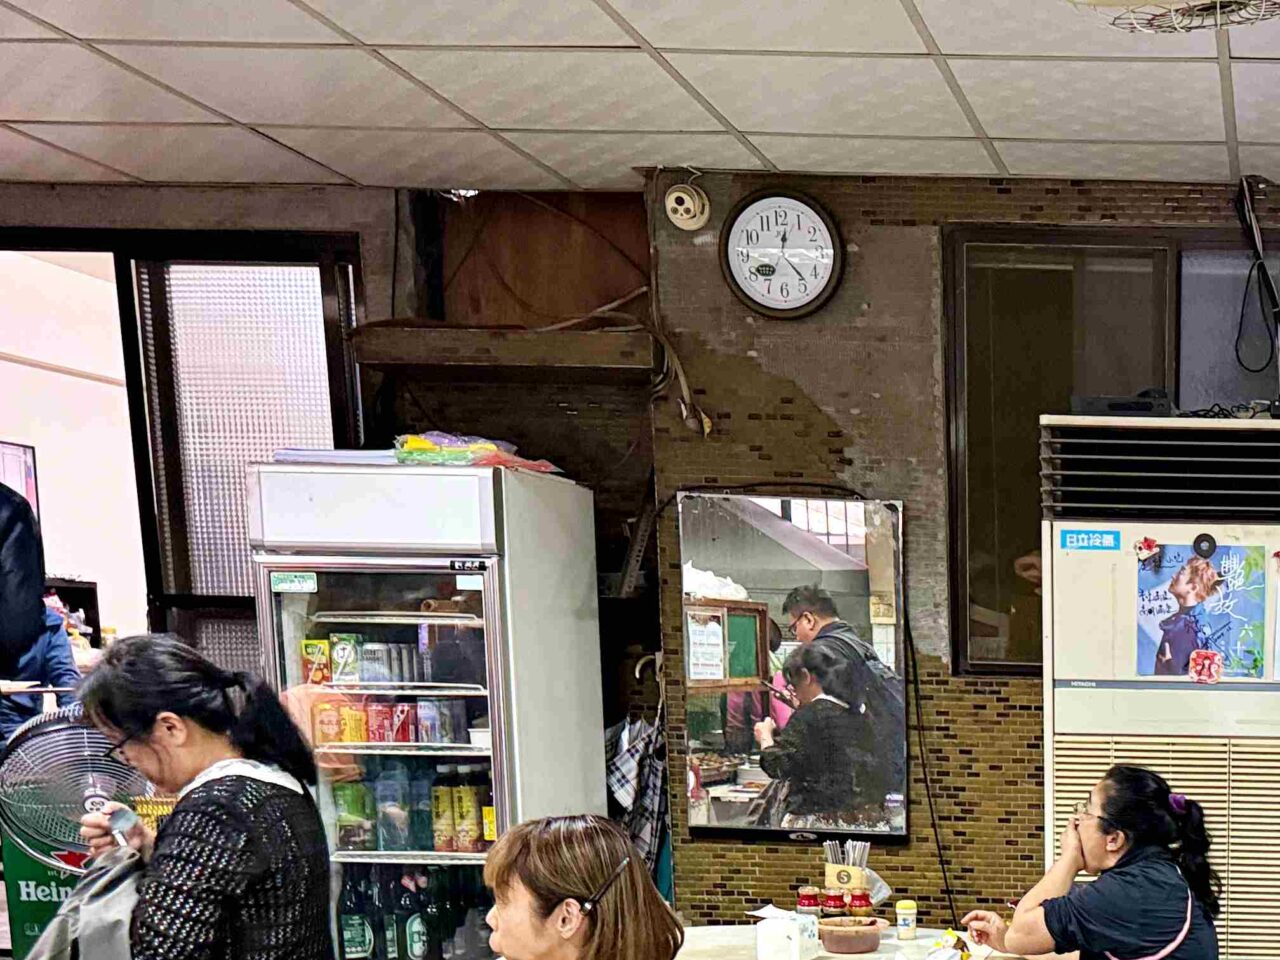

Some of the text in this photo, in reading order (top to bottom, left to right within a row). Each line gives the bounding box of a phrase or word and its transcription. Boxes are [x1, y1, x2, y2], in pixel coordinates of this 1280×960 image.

[759, 214, 770, 232] 11
[774, 209, 788, 226] 12
[745, 229, 759, 246] 10
[808, 226, 818, 242] 2
[740, 248, 750, 263] 9
[748, 265, 759, 282] 8
[810, 264, 819, 280] 4
[763, 278, 772, 294] 7
[780, 282, 790, 298] 6
[798, 278, 808, 294] 5
[1066, 533, 1115, 547] 日立冷氣
[17, 880, 73, 902] Hein
